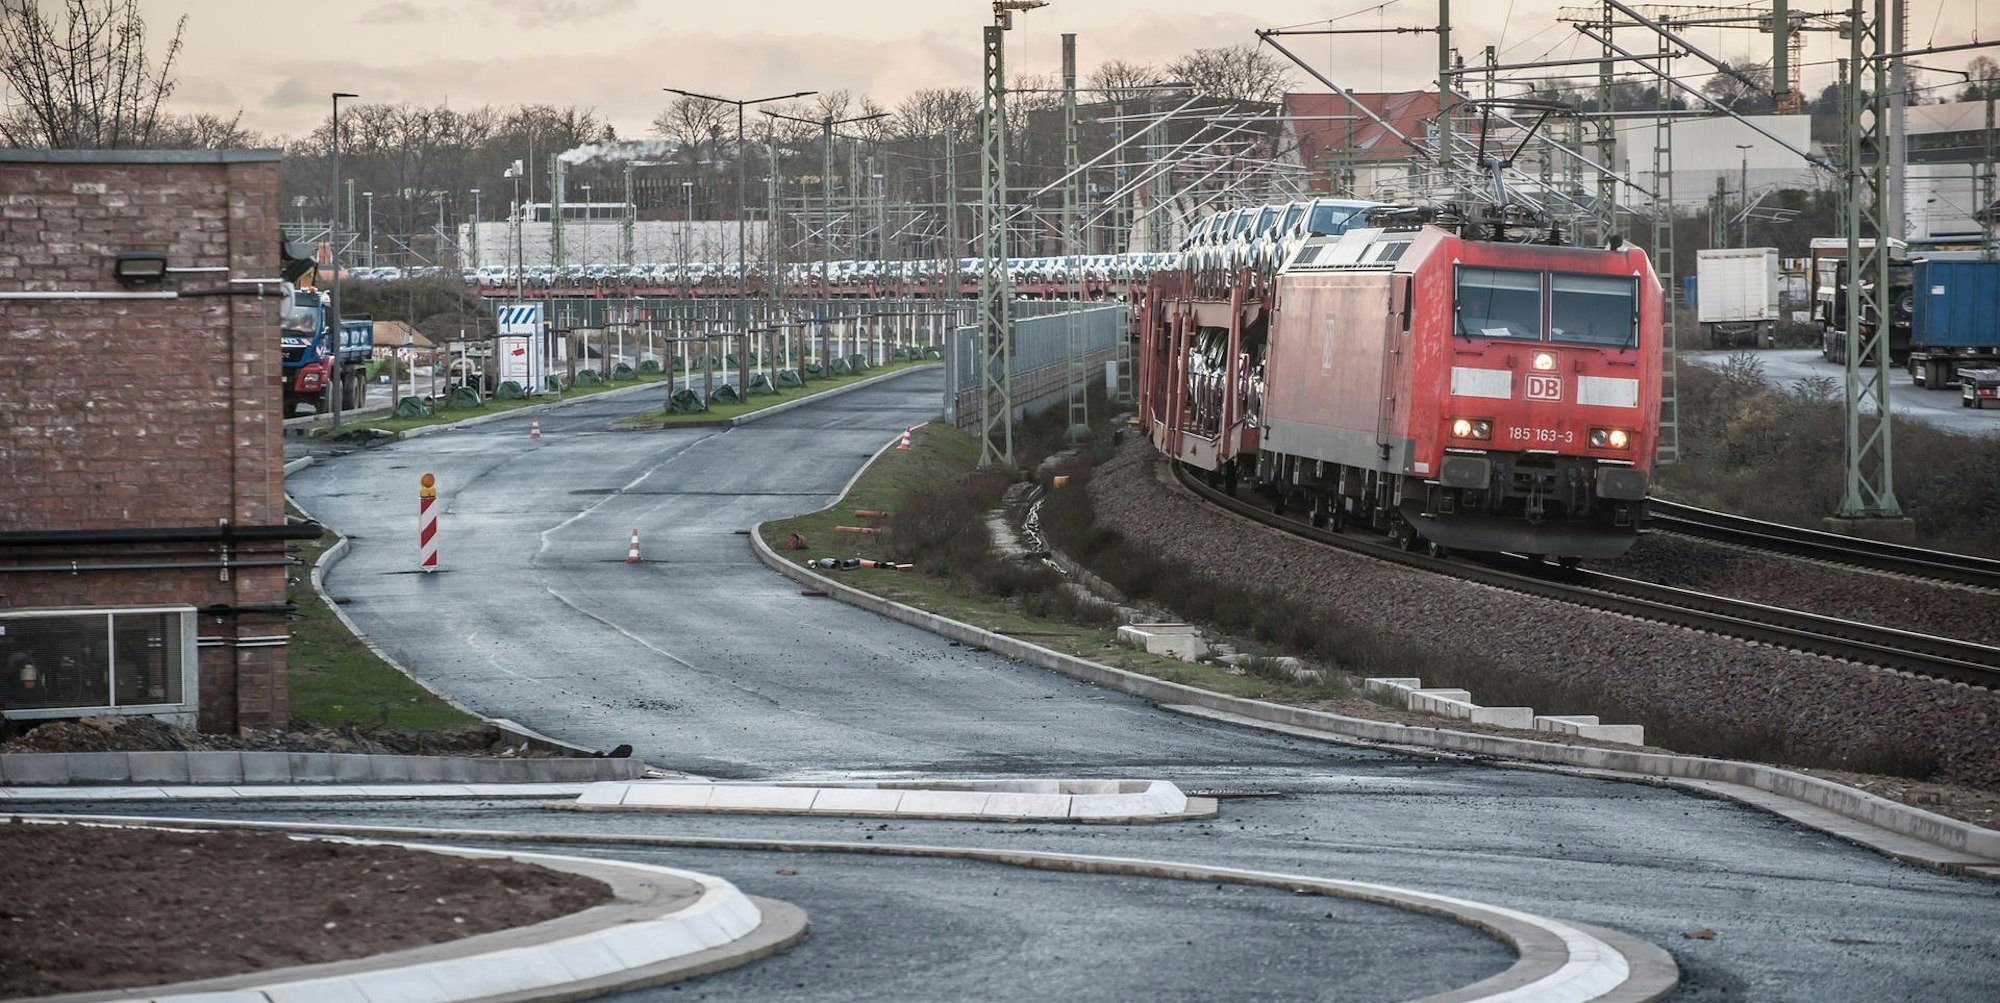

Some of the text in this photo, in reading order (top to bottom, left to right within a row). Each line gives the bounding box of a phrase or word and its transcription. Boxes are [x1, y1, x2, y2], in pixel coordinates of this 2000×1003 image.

[1530, 378, 1559, 398] DB
[1509, 426, 1574, 444] 185 163-3
